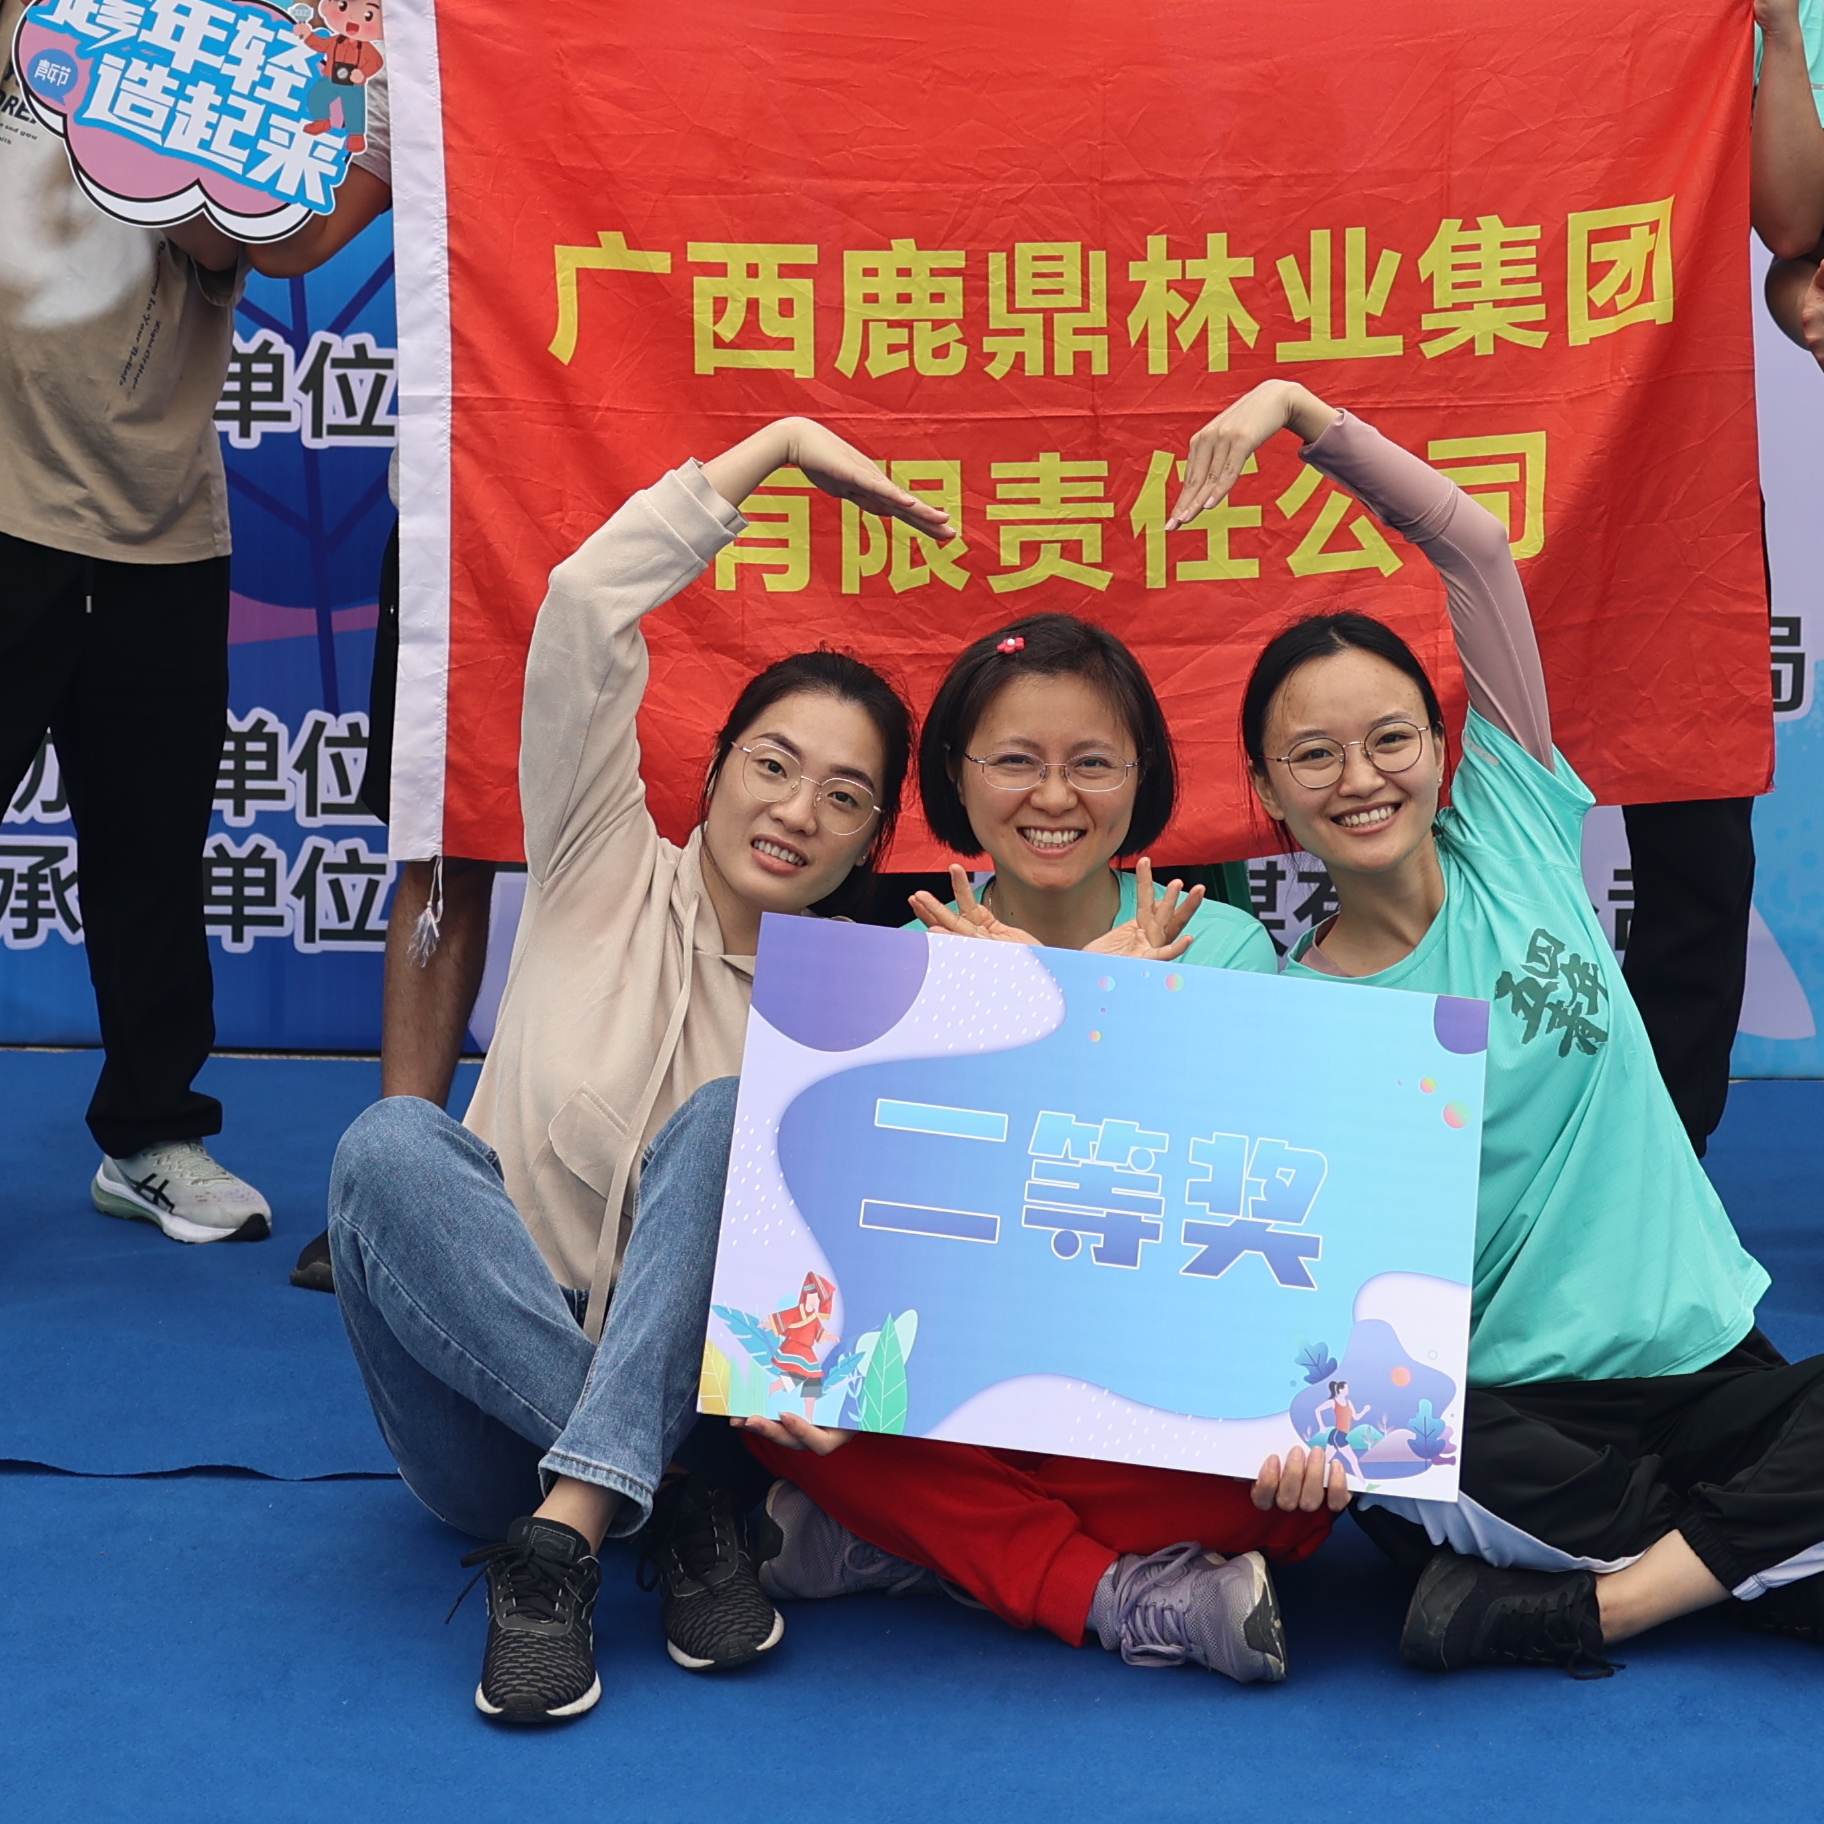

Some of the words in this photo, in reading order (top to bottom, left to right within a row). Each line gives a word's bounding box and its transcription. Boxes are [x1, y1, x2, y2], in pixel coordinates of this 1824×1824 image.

[33, 58, 73, 88] 青年节
[83, 54, 348, 207] 造起来
[547, 194, 1675, 381] 广西鹿鼎林业集团
[213, 337, 396, 441] 单位
[713, 431, 1548, 596] 有限责任公司
[858, 1094, 1329, 1292] 二等奖
